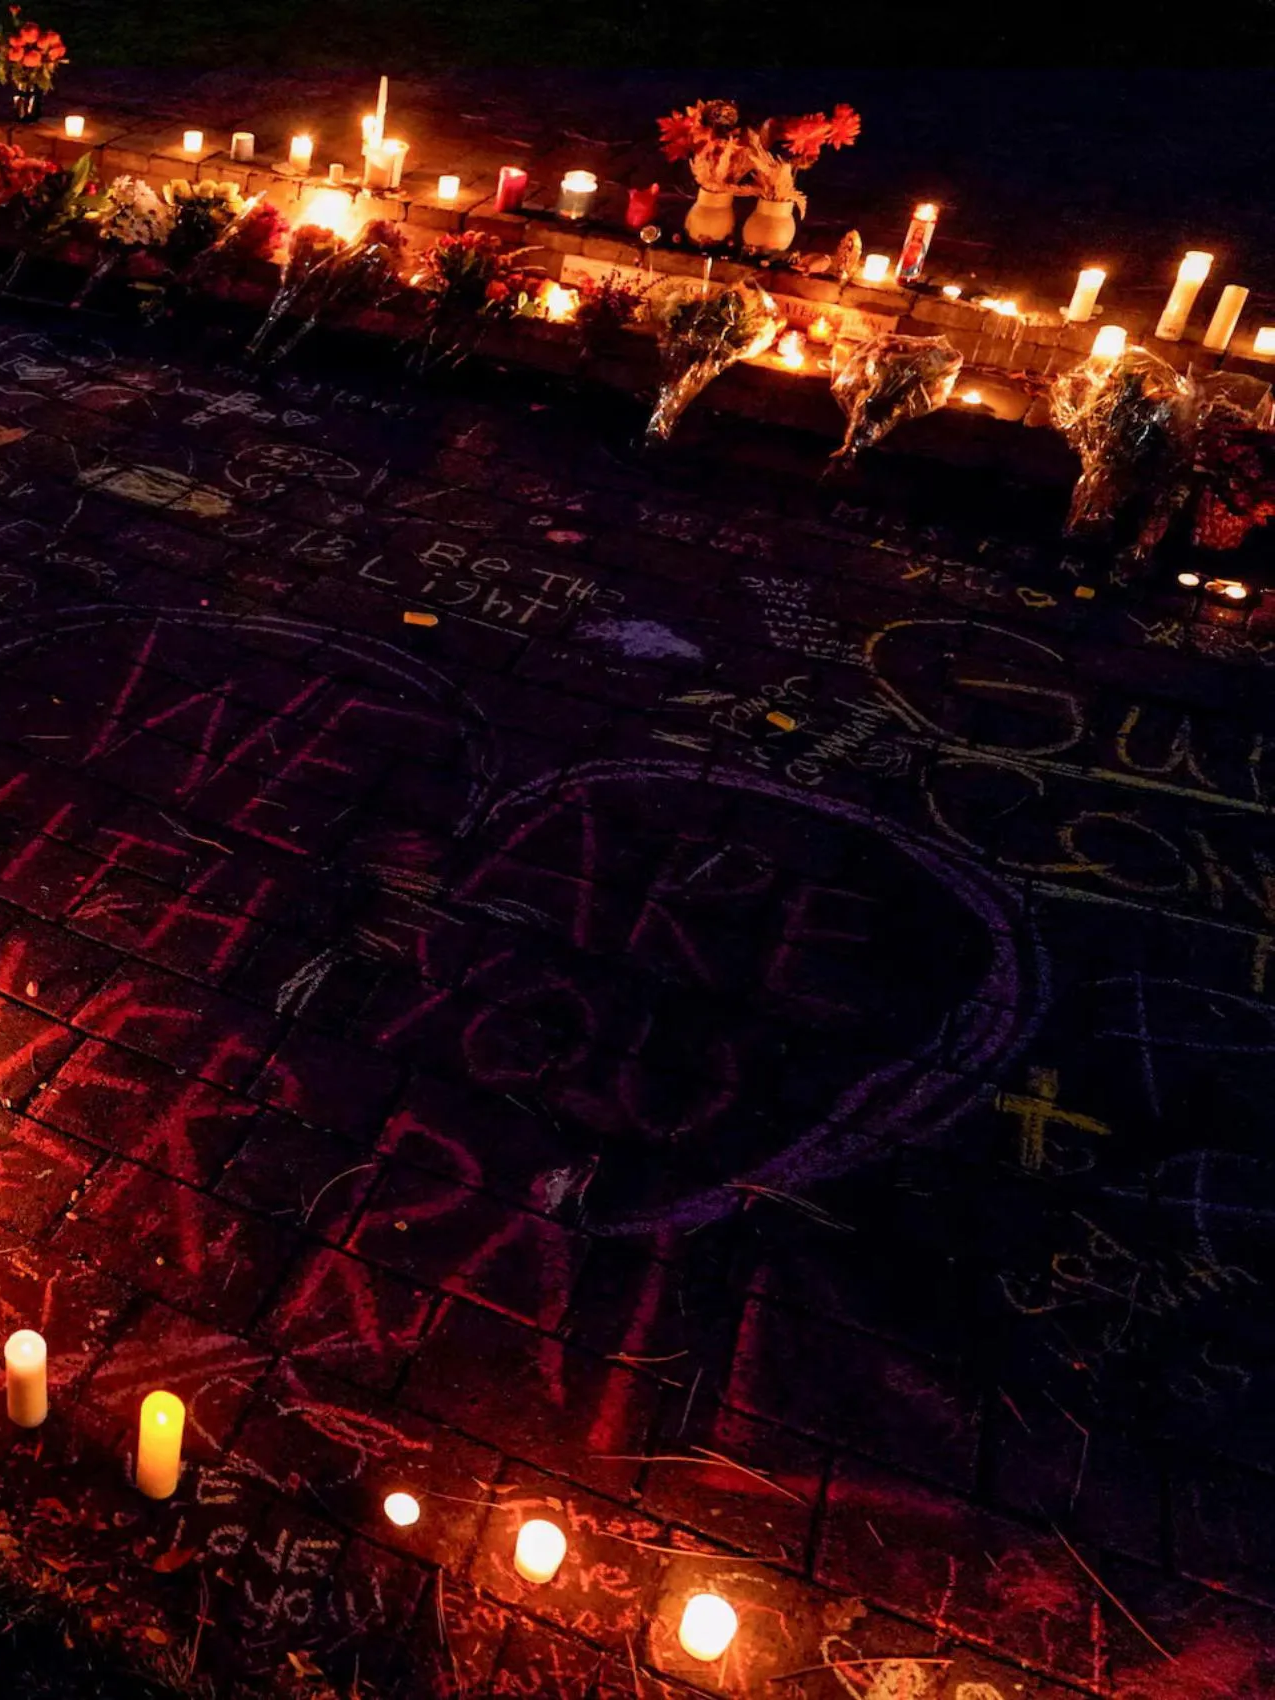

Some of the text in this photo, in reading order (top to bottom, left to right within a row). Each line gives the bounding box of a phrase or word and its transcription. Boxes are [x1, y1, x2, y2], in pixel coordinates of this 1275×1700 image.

[78, 616, 886, 1021] WE ARE
[374, 918, 745, 1143] YOU
